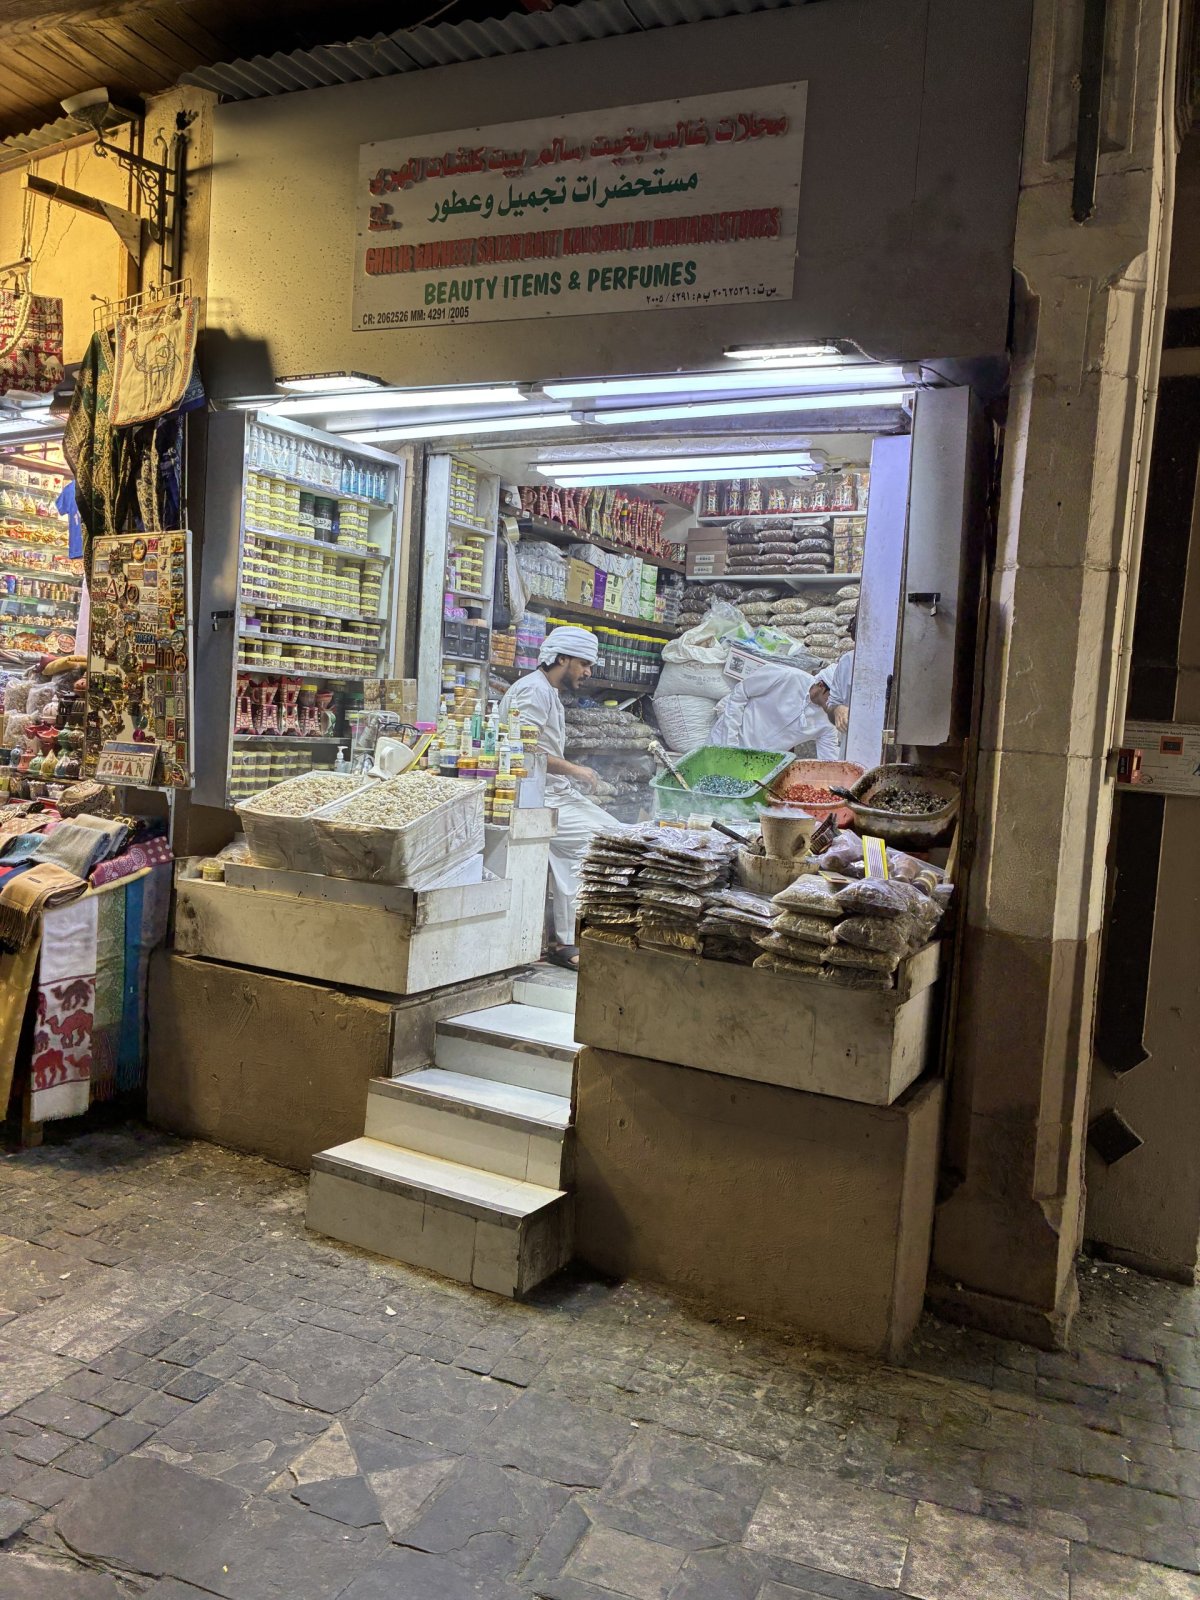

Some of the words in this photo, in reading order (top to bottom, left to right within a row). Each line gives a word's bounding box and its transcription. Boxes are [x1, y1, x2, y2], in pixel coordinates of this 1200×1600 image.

[653, 118, 709, 160] غالب
[715, 113, 789, 144] محلات
[532, 137, 586, 167] سالم
[589, 128, 649, 166] بخيت
[498, 176, 566, 217] تجميل
[571, 168, 698, 209] مستحضرات
[427, 189, 494, 223] وعطور
[719, 207, 780, 241] STORES
[424, 275, 498, 305] BEAUTY
[503, 271, 562, 299] ITEMS
[567, 270, 581, 291] &
[587, 260, 697, 292] PERFUMES
[362, 314, 375, 326] CR:
[377, 310, 409, 324] 2062526
[410, 309, 426, 322] MM:
[427, 307, 447, 320] 4291
[102, 759, 148, 777] OMAN
